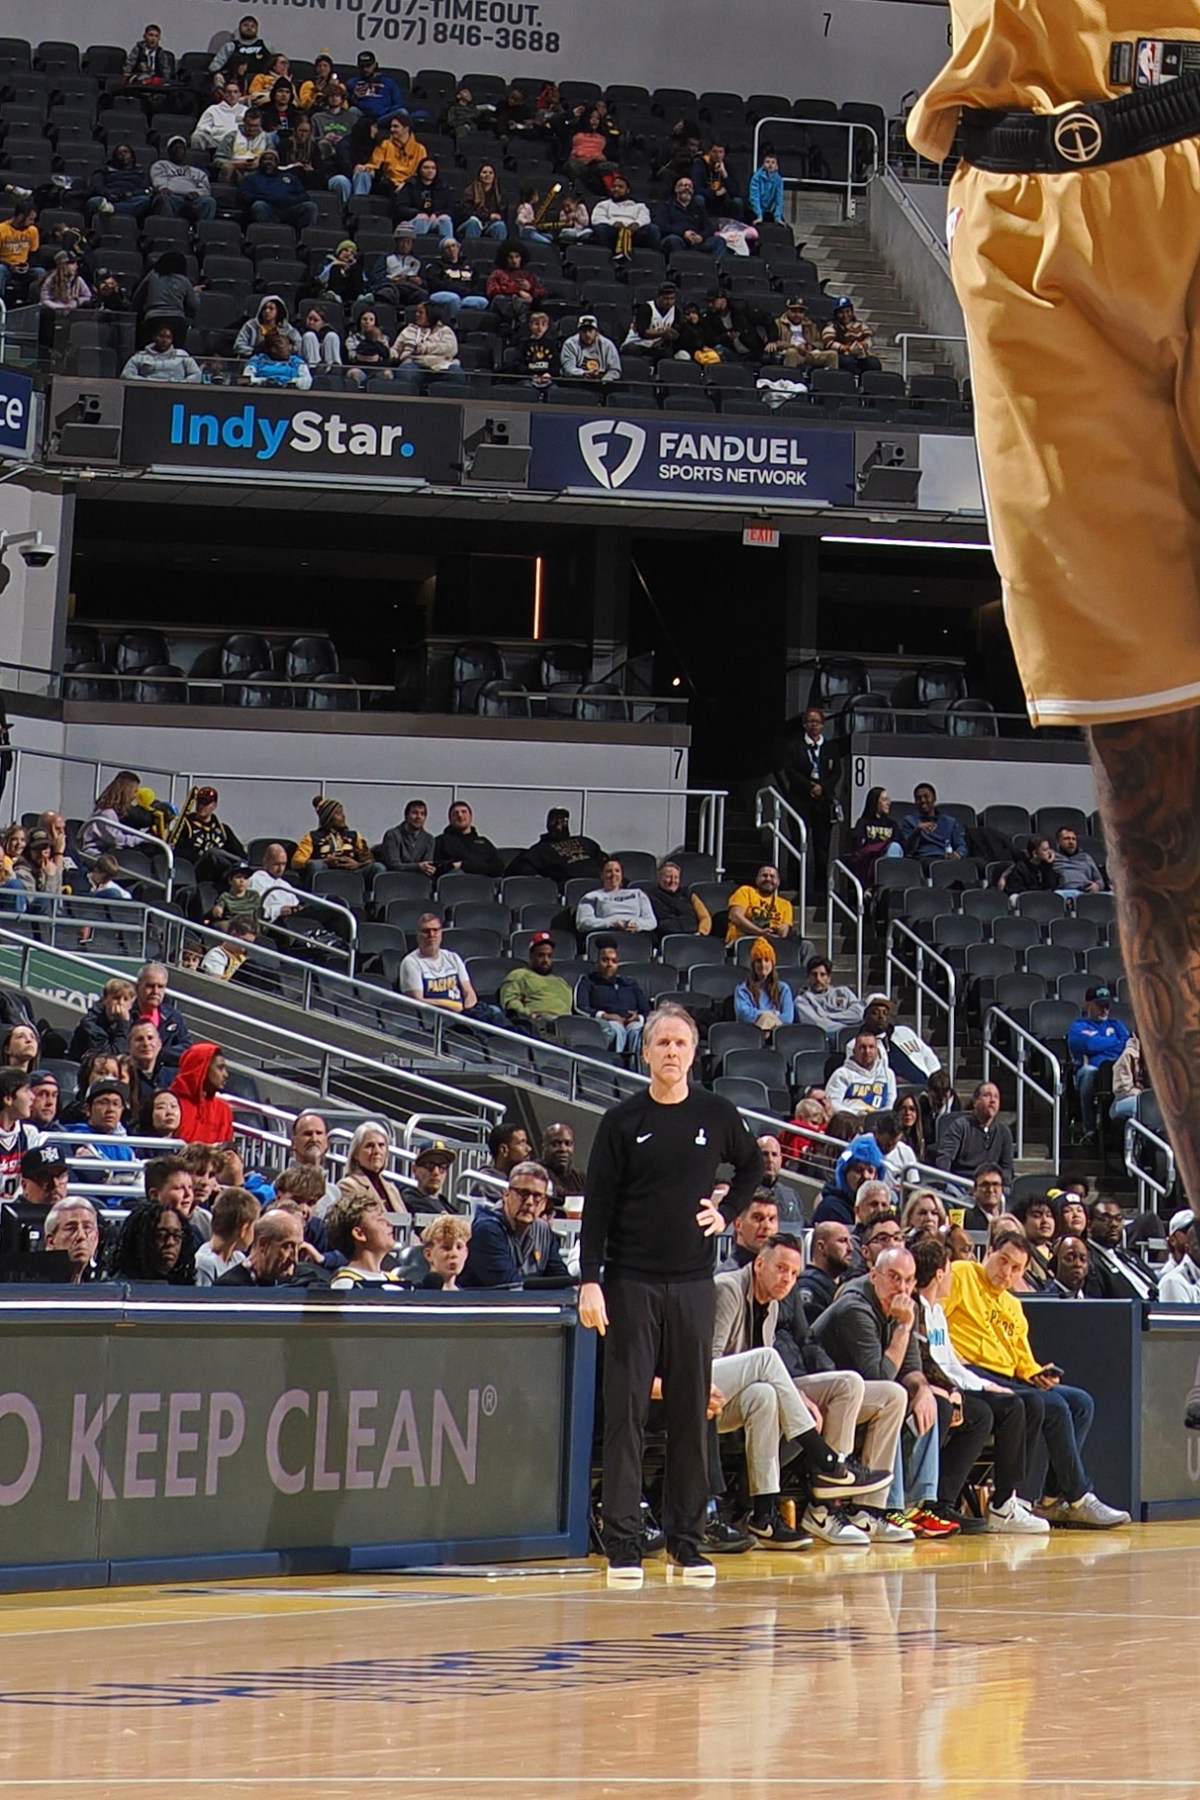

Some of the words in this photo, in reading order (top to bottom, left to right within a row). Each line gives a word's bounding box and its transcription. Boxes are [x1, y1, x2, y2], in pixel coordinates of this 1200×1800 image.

[357, 12, 426, 45] (707)
[433, 22, 560, 53] 846-3688
[823, 12, 832, 38] 7
[169, 403, 415, 459] IndyStar.
[659, 432, 808, 466] FANDUEL
[659, 465, 724, 483] SPORTS
[726, 467, 808, 486] NETWORK
[746, 523, 773, 543] EXIT
[673, 748, 684, 779] 7
[854, 757, 866, 787] 8
[67, 1391, 246, 1502] KEEP
